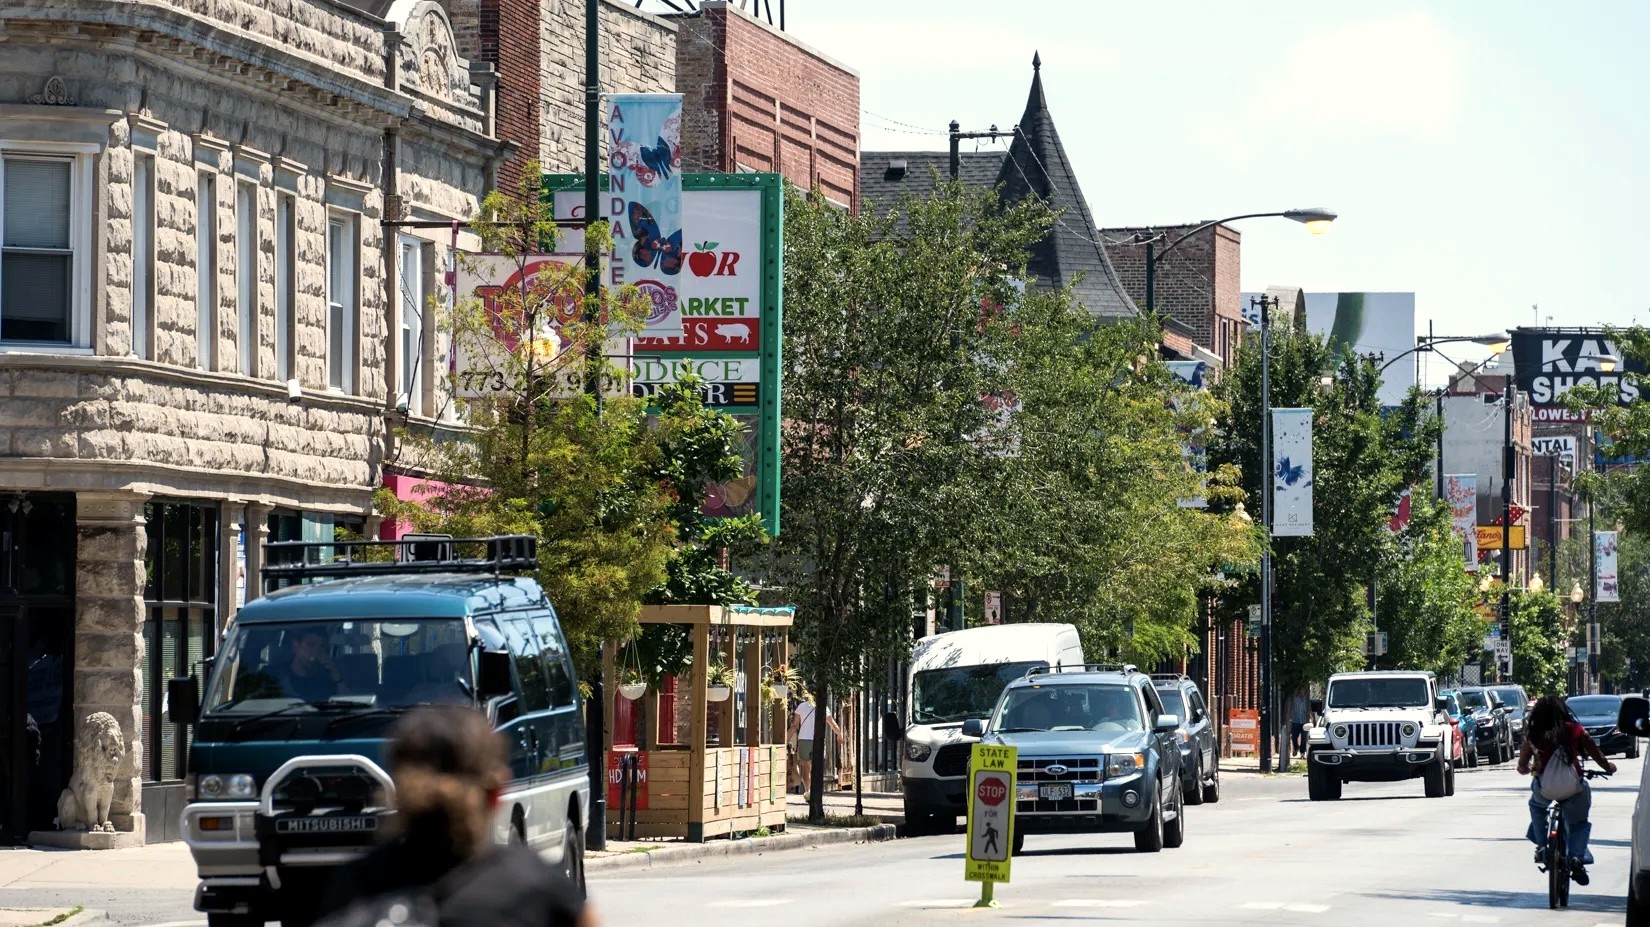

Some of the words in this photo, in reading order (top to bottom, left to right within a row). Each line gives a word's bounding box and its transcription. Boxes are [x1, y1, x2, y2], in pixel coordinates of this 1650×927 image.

[610, 104, 627, 286] AVONDALE
[979, 748, 1010, 759] STATE
[983, 759, 1005, 769] LAW
[979, 784, 1006, 798] STOP
[984, 809, 998, 819] FOR
[287, 818, 367, 832] MITSUBISHI
[977, 862, 1000, 872] WITHIN
[969, 871, 1006, 881] CROSSWALK
